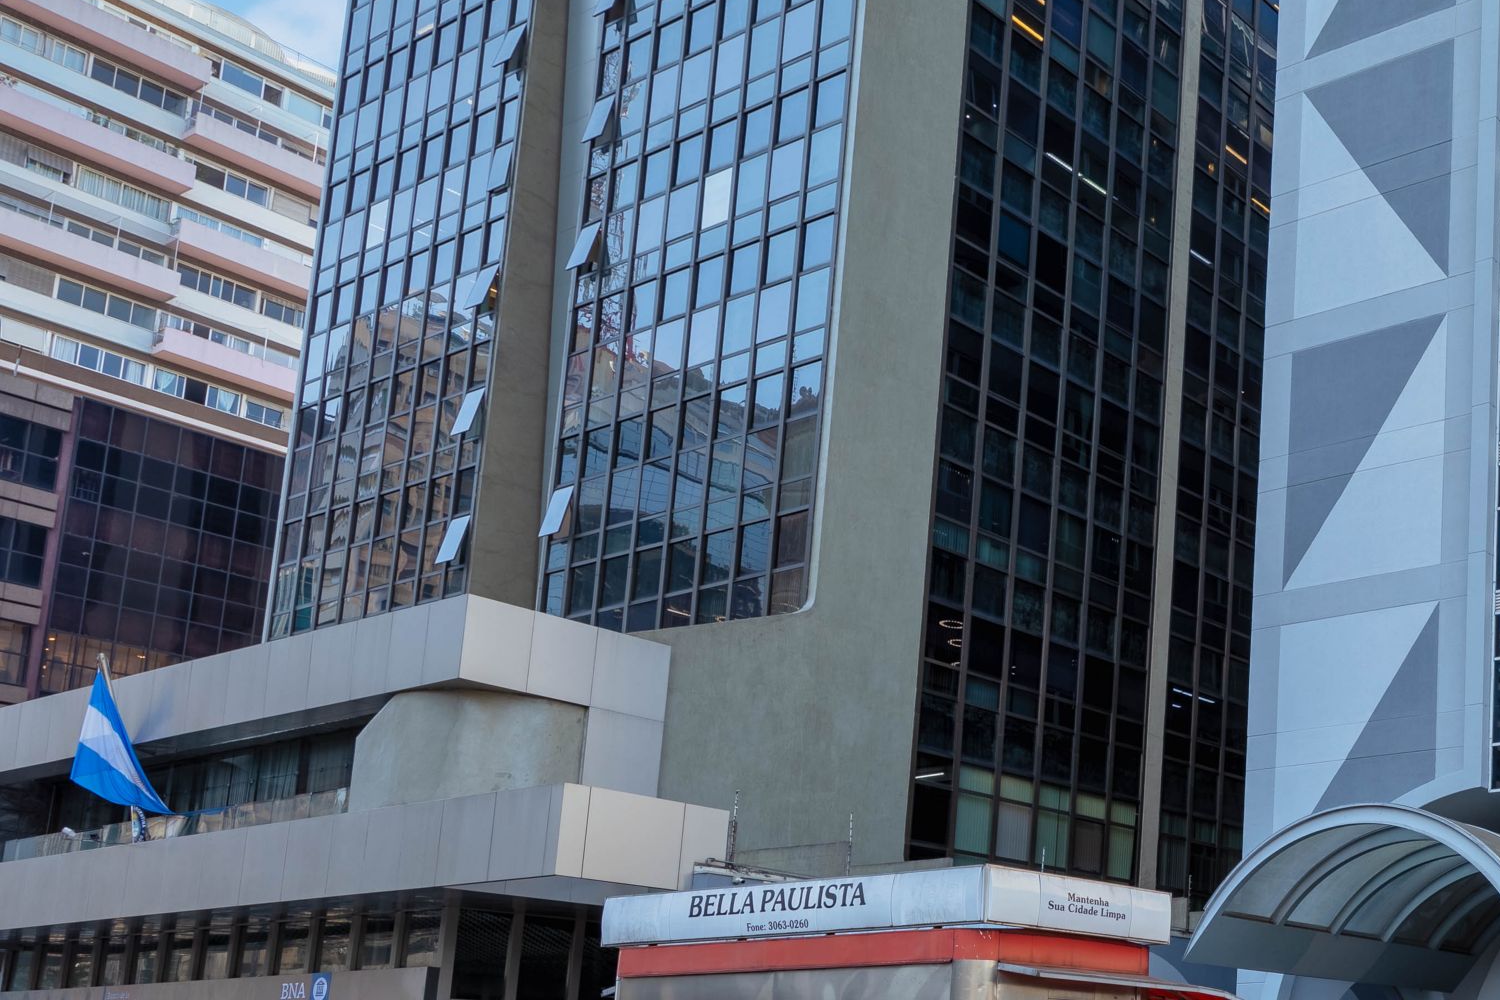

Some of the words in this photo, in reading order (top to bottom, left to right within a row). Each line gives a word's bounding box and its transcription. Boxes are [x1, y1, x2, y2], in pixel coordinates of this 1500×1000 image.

[688, 890, 755, 918] BELLA
[760, 882, 867, 913] PAULISTA
[1067, 892, 1110, 907] Mantenha
[1047, 900, 1065, 912] Sua
[1068, 903, 1099, 916] Cidade
[1100, 908, 1126, 921] Limpa
[746, 922, 767, 932] Fone:
[768, 918, 809, 931] 3063-0260
[280, 982, 305, 1000] BNA
